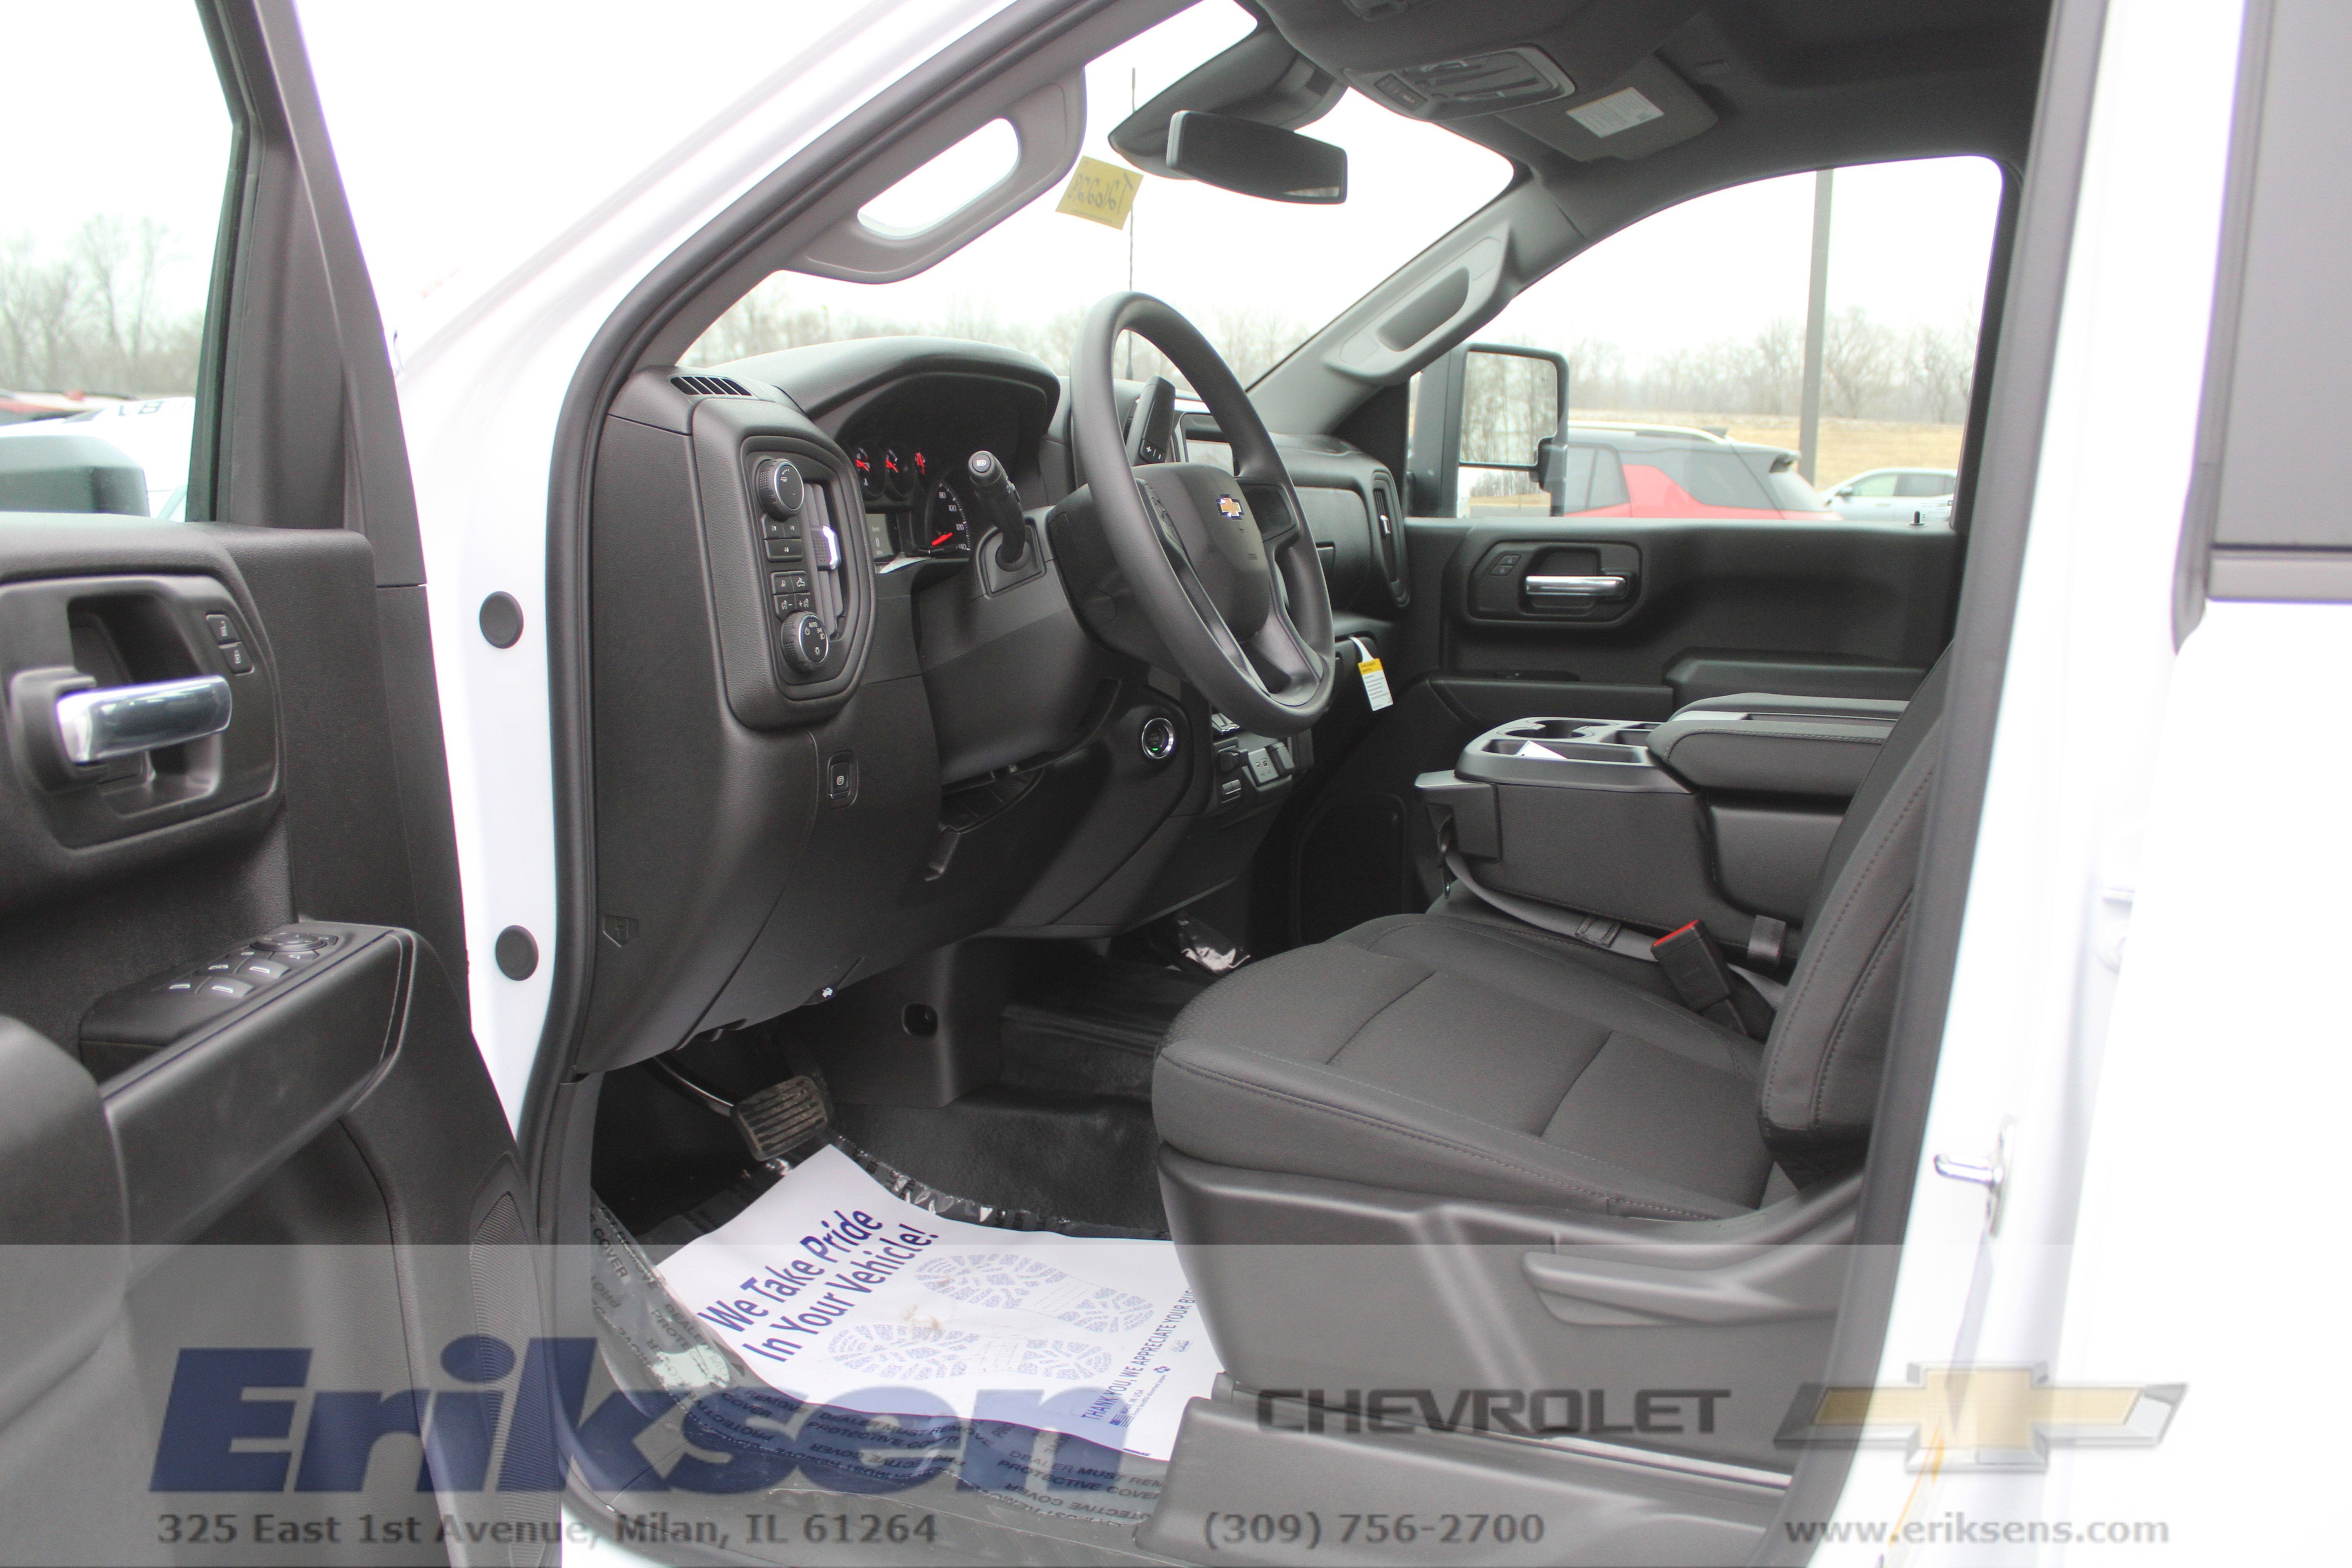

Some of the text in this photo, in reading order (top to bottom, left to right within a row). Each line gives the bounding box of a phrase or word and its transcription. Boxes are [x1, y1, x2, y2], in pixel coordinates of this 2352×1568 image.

[593, 1227, 628, 1278] COVER
[697, 1210, 882, 1332] We Take Pride
[742, 1223, 938, 1362] In Your Vehicle!
[1162, 1304, 1192, 1323] YOUR
[1130, 1324, 1177, 1366] APPRECIATE
[1118, 1366, 1144, 1377] WE
[1103, 1379, 1137, 1396] YOU,
[721, 1392, 772, 1417] COVER
[745, 1390, 808, 1414] REMOVE
[1080, 1396, 1119, 1421] THANK
[818, 1412, 880, 1428] DEALER
[806, 1422, 904, 1446] PROTECTIVE
[809, 1443, 863, 1459] COVER
[998, 1459, 1102, 1491] PROTECTIVE
[1009, 1450, 1074, 1473] DEALER
[1076, 1467, 1127, 1481] MUST
[1005, 1483, 1064, 1506] COVER
